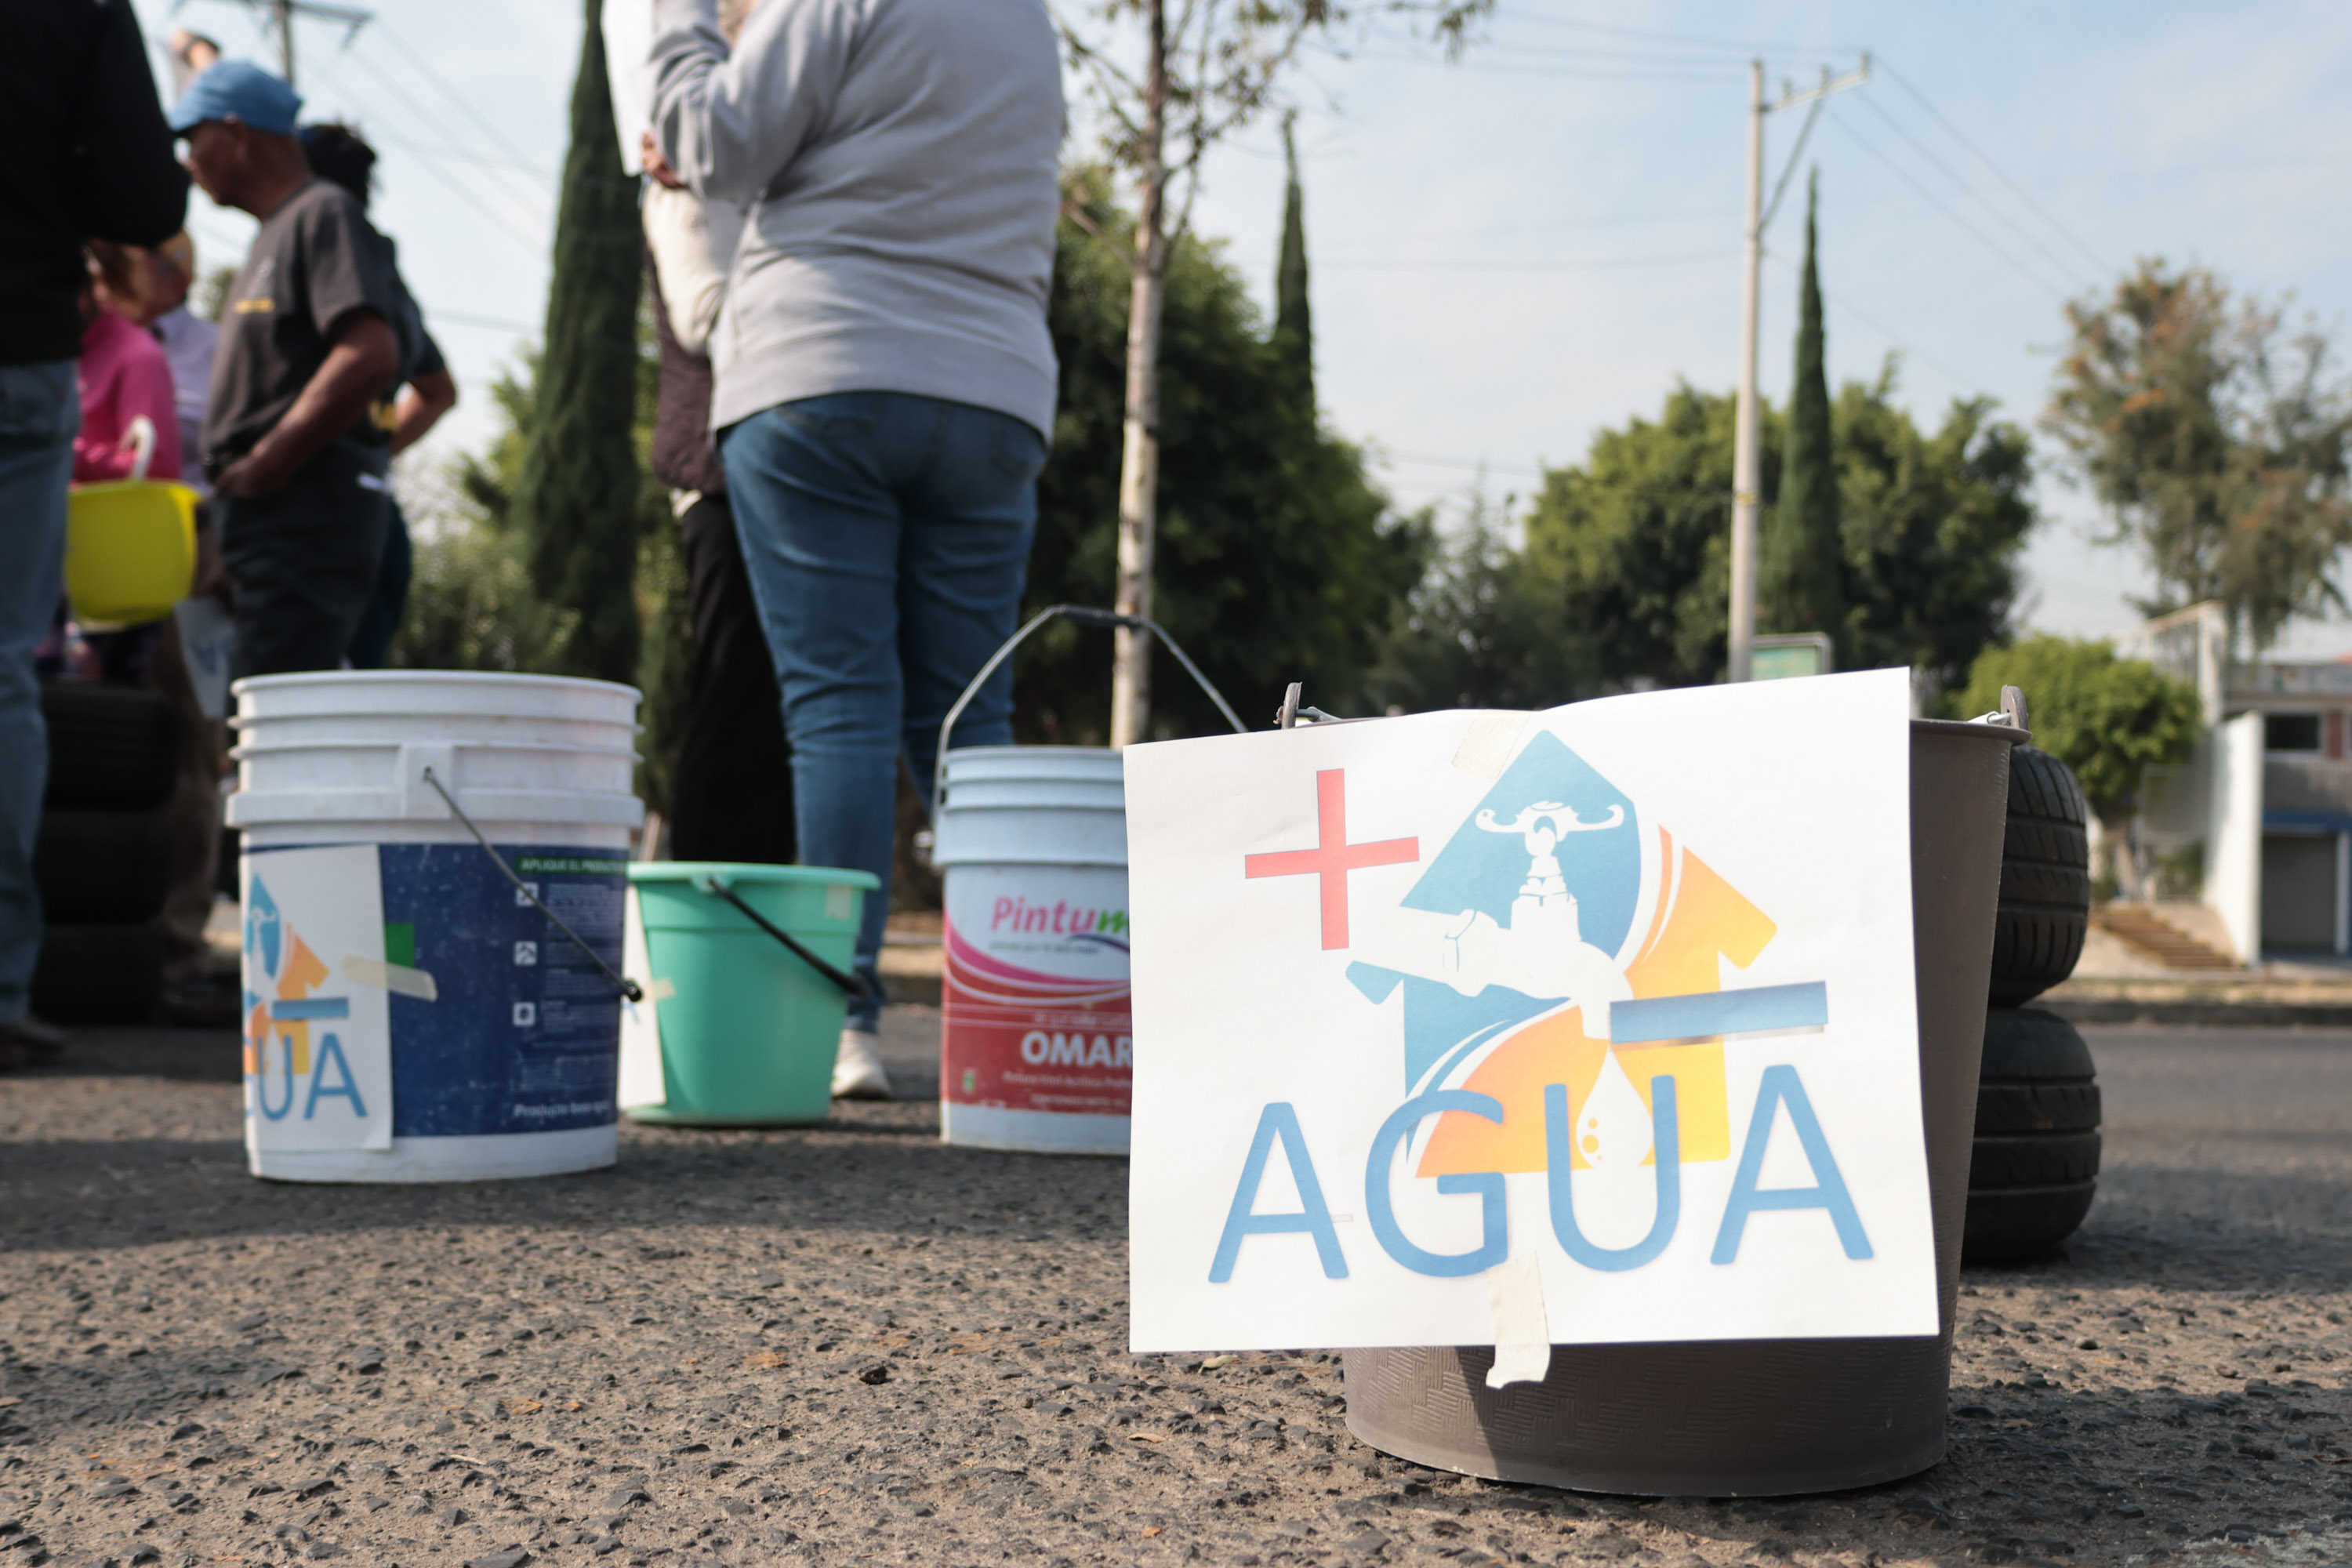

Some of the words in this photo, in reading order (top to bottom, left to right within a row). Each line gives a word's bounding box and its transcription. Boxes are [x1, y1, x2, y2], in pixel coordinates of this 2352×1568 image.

[521, 858, 566, 871] APLIQUE
[990, 895, 1130, 935] Pintum
[1022, 1029, 1132, 1068] OMAR
[245, 1033, 367, 1122] UA
[514, 1103, 568, 1117] Producto
[1208, 1065, 1874, 1283] AGUA
